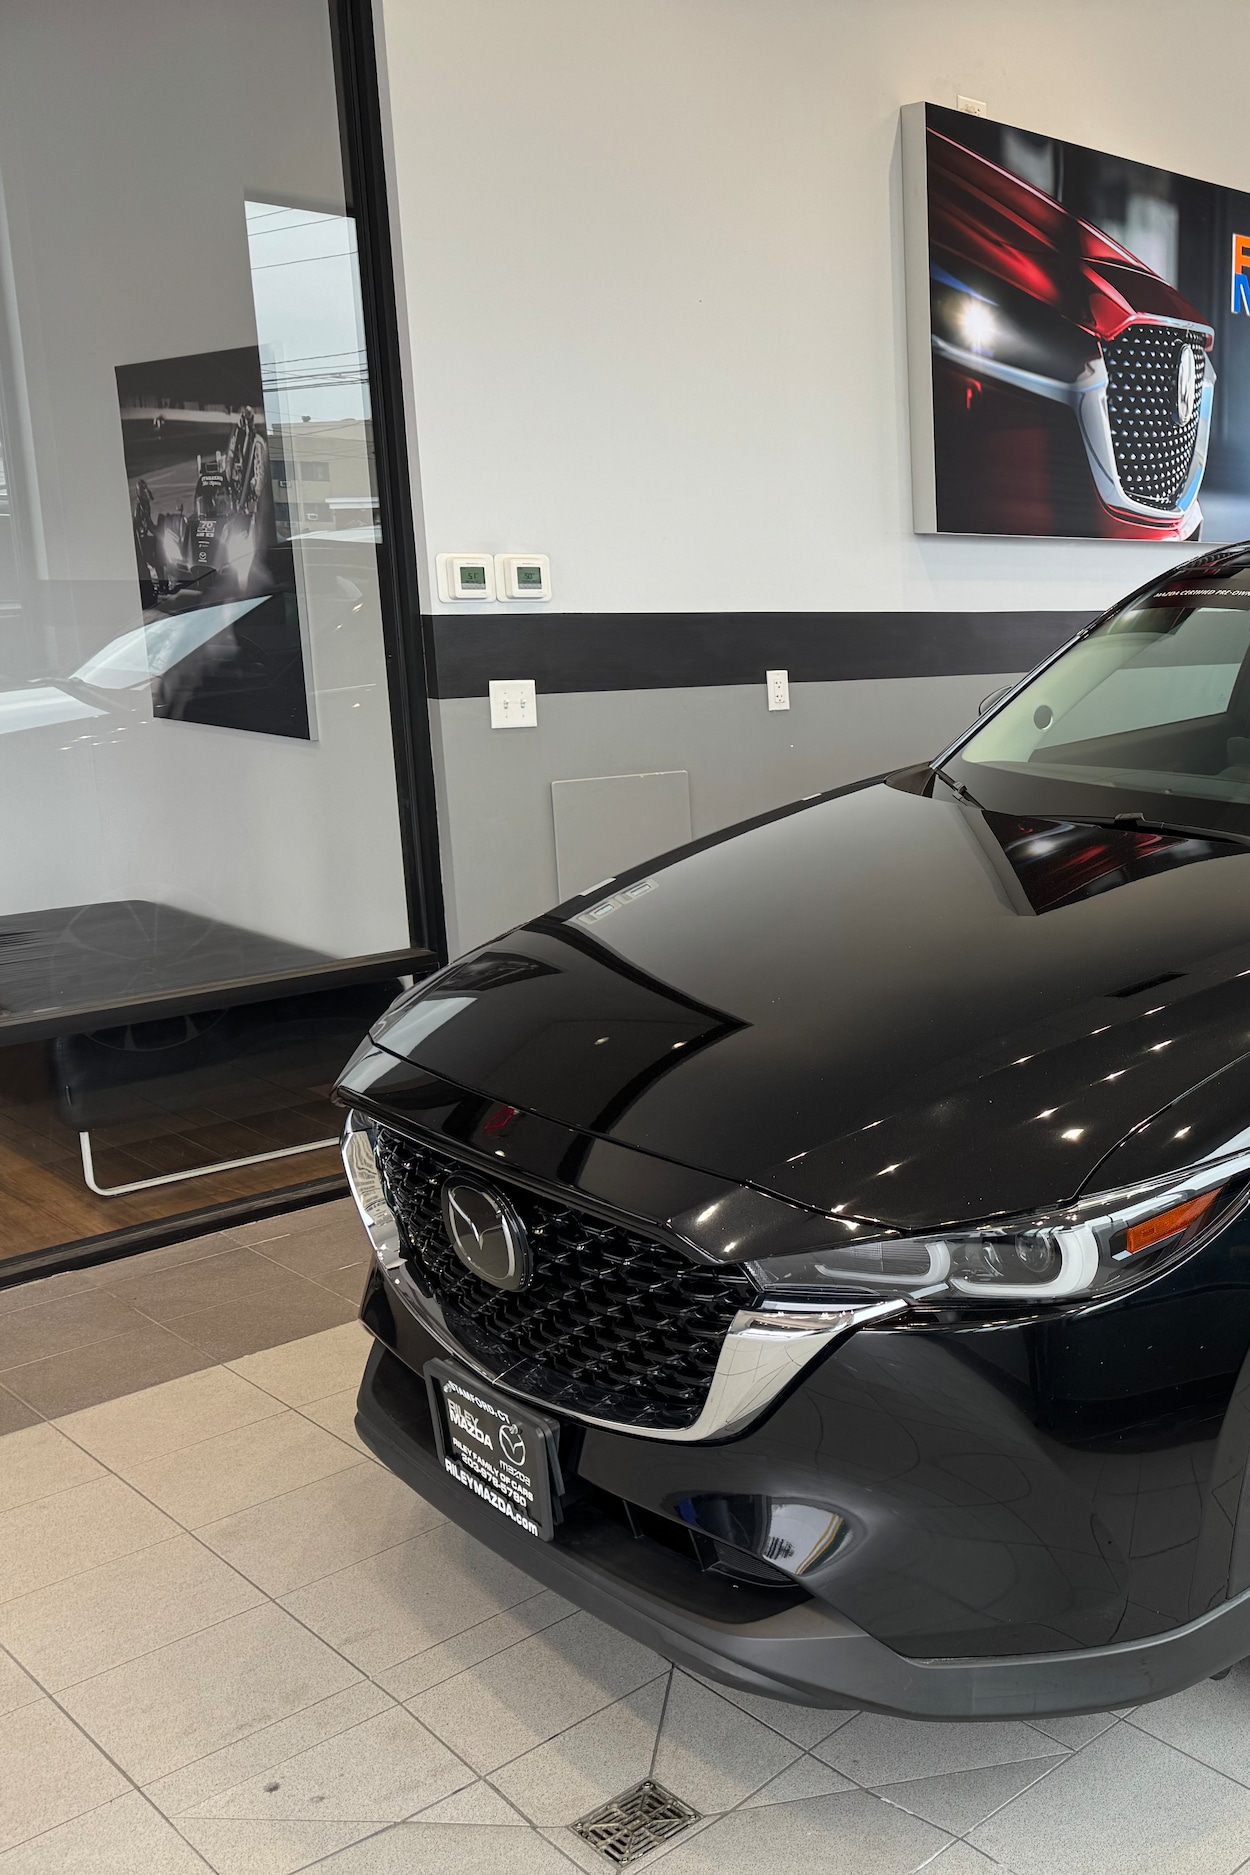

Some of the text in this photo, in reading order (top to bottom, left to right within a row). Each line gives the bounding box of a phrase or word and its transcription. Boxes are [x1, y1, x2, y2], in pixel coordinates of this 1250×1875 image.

[447, 1398, 480, 1428] RILEY
[449, 1409, 494, 1451] MAZDA
[452, 1437, 534, 1502] RILEY FAMILY OF CARS
[499, 1459, 531, 1487] mazda
[445, 1458, 538, 1537] RILEYMAZDA.com
